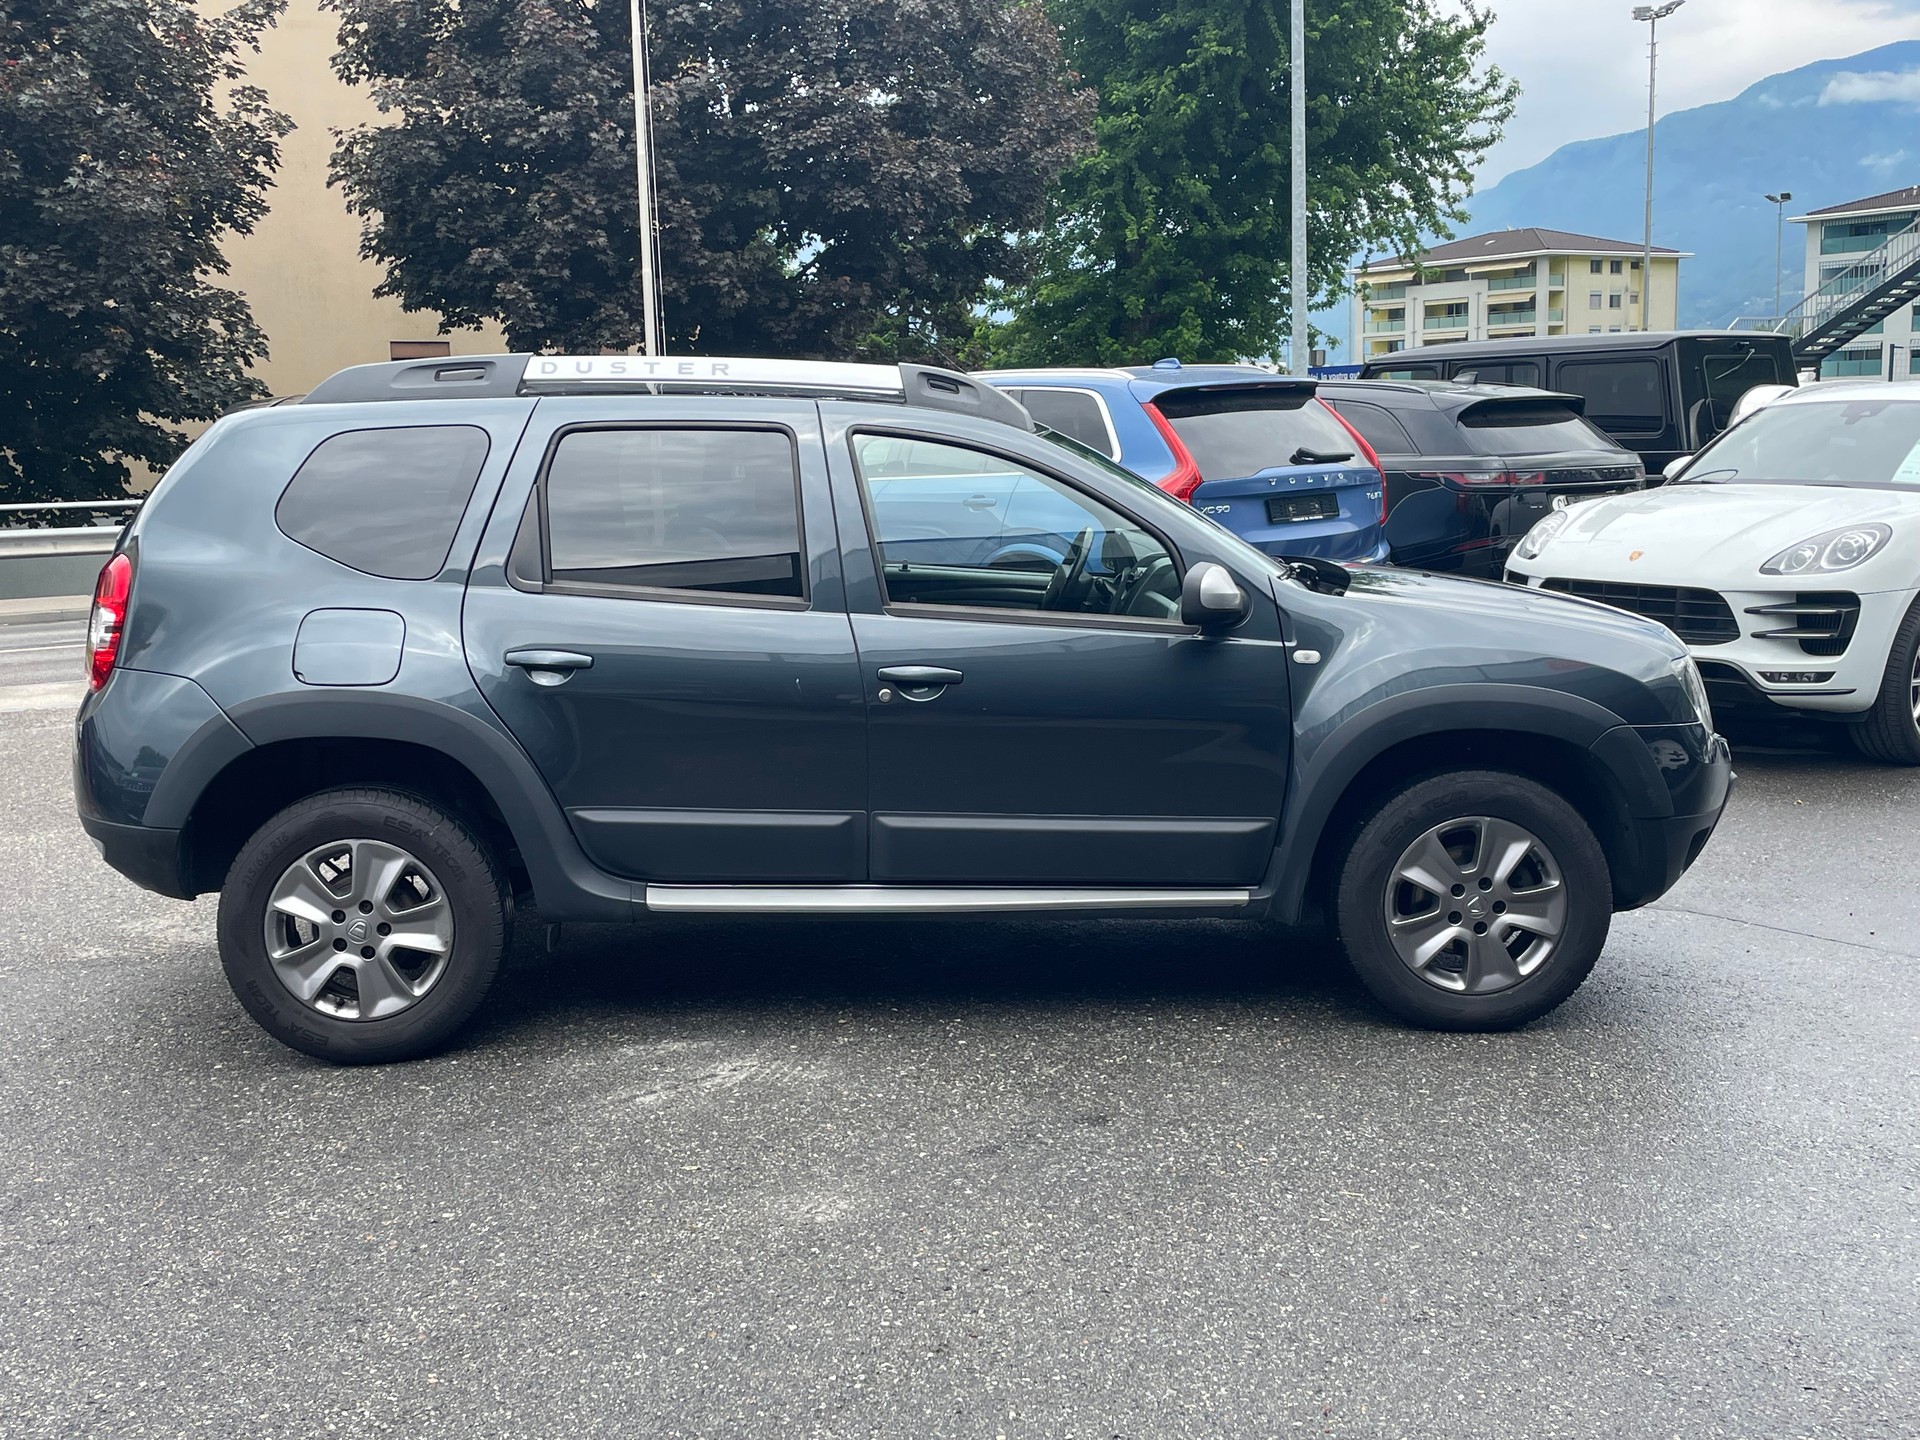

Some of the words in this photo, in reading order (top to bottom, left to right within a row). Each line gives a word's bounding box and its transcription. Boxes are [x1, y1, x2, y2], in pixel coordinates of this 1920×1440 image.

[541, 361, 729, 376] DUSTER
[1268, 472, 1344, 486] VOLVO
[1201, 505, 1231, 514] XC90
